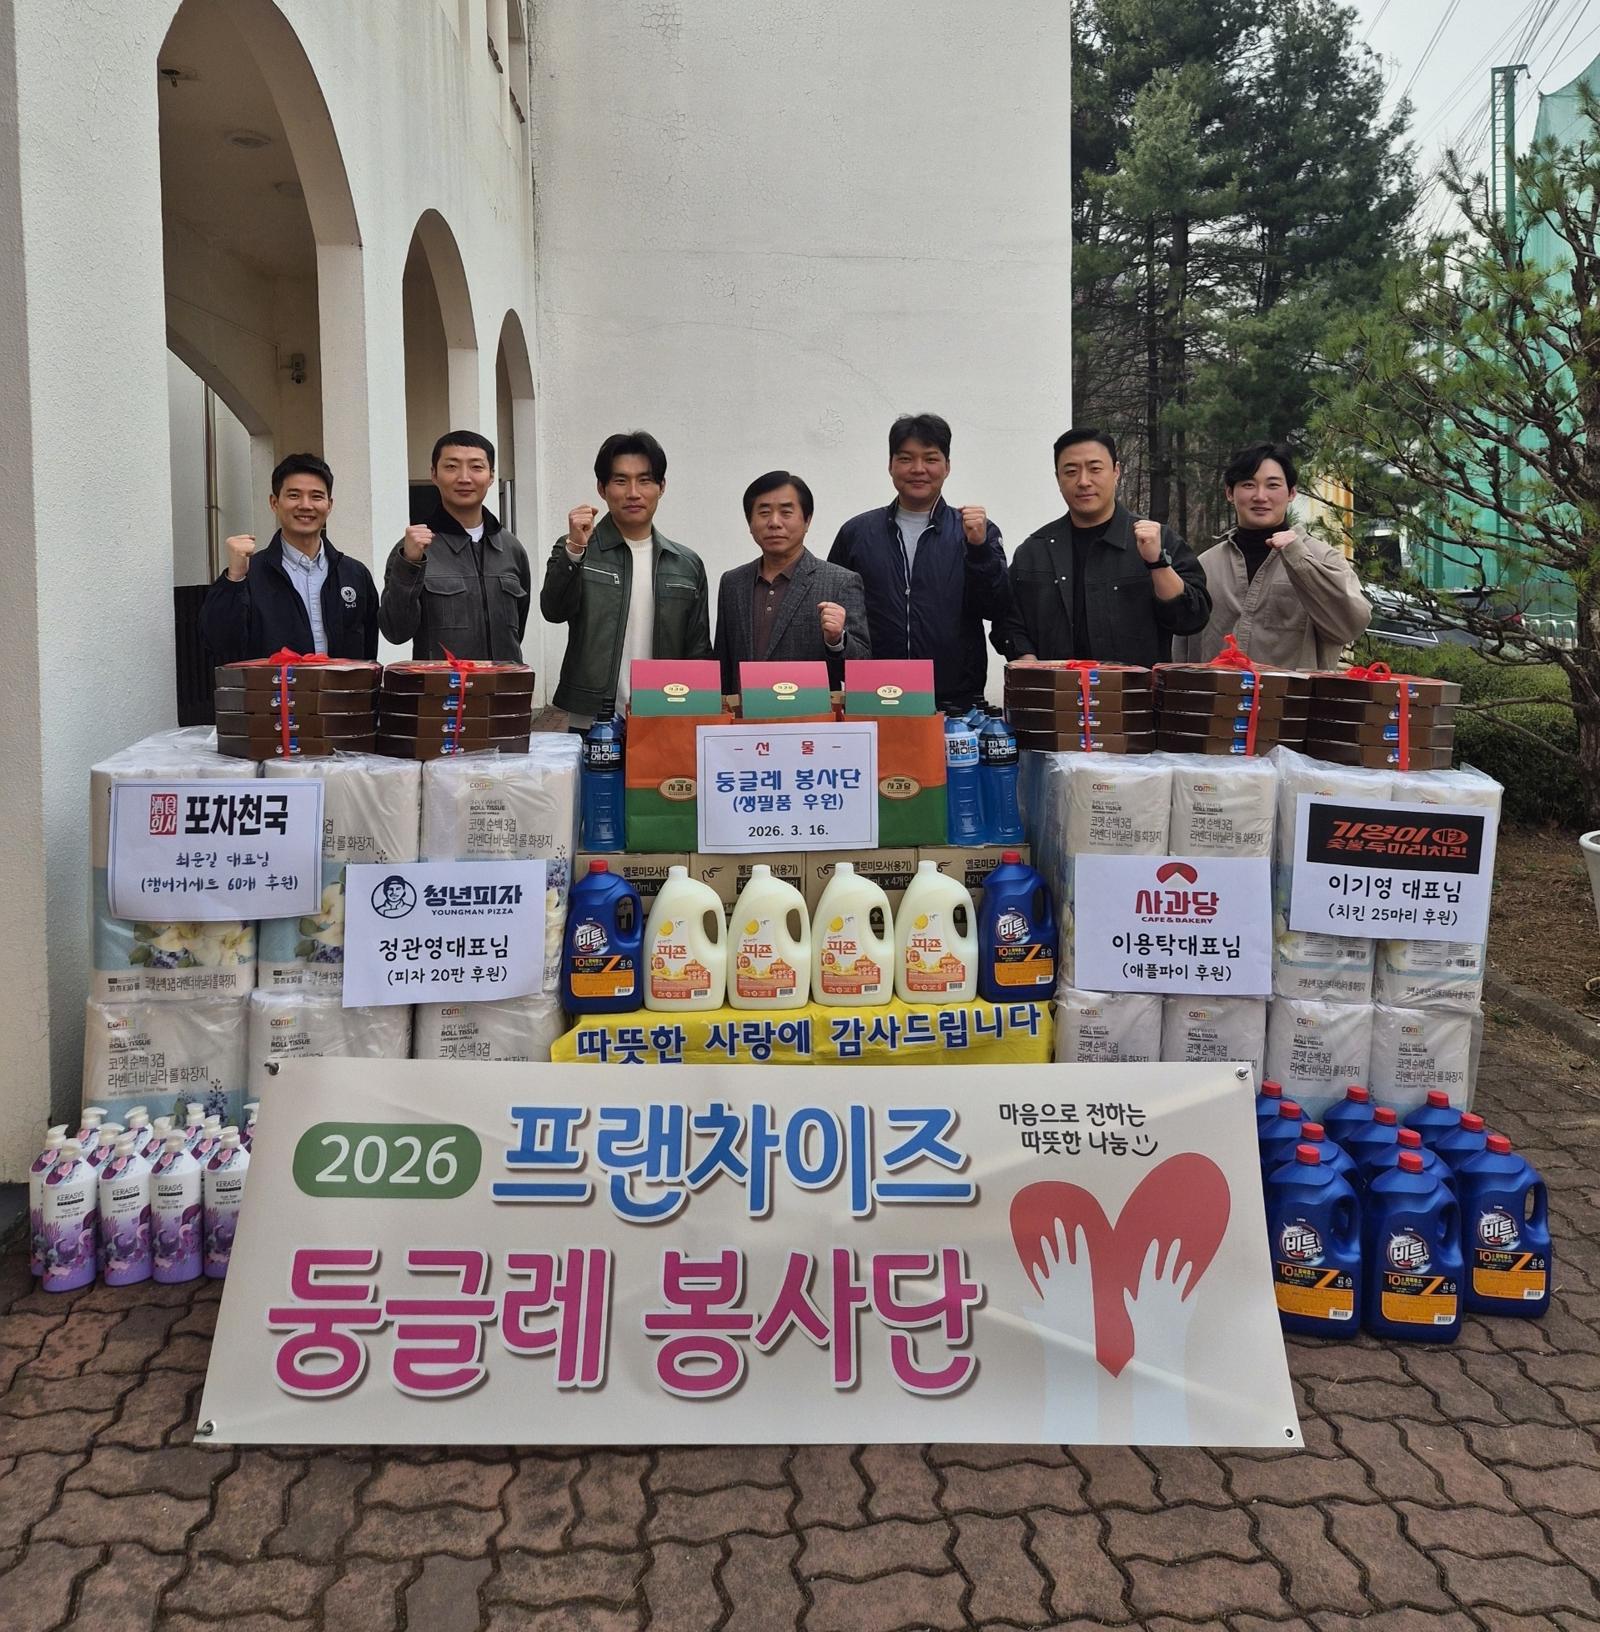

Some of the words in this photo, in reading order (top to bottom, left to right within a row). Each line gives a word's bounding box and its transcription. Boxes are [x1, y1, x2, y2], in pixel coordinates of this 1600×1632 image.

[755, 742, 770, 756] 선
[801, 740, 815, 755] 물
[716, 770, 782, 792] 둥글레
[795, 768, 861, 790] 봉사단
[733, 794, 792, 813] (생필품
[803, 793, 843, 811] 후원)
[185, 794, 288, 835] 포차천국
[748, 826, 784, 837] 2026.
[791, 825, 801, 836] 3.
[809, 825, 828, 836] 16.
[1333, 821, 1430, 843] 기영이
[227, 851, 270, 868] 대표님
[1365, 841, 1467, 858] 두마리치킨
[141, 876, 219, 892] (햄버거세트
[228, 875, 256, 891] 60개
[265, 874, 298, 891] 후원)
[1329, 873, 1392, 900] 이기영
[1402, 878, 1461, 903] 대표님
[423, 885, 523, 907] 청년피자
[1135, 890, 1220, 916] 사과당
[1328, 903, 1365, 921] (치킨
[1371, 908, 1417, 924] 25마리
[1423, 908, 1457, 926] 후원)
[1000, 917, 1025, 936] 비트
[577, 928, 602, 946] 비트
[911, 938, 941, 952] 피죤
[1112, 932, 1240, 959] 이용탁대표님
[379, 935, 509, 962] 정관영대표님
[657, 945, 687, 959] 피죤
[742, 944, 773, 958] 피죤
[827, 940, 857, 955] 피죤
[388, 968, 425, 986] (피자
[431, 966, 464, 984] 20판
[471, 966, 507, 983] 후원)
[1122, 963, 1188, 980] (애플파이
[1195, 964, 1232, 982] 후원)
[577, 1024, 686, 1064] 따뜻한
[704, 1020, 811, 1060] 사랑에
[830, 1003, 1041, 1058] 감사드립니다
[999, 1103, 1080, 1127] 마음으로
[1086, 1103, 1146, 1127] 전하는
[1021, 1131, 1081, 1155] 따뜻한
[1088, 1131, 1129, 1156] 나눔
[314, 1132, 459, 1186] 2026
[491, 1103, 974, 1221] 프랜차이즈
[1484, 1219, 1513, 1238] 비트
[1286, 1232, 1316, 1251] 비트
[1393, 1242, 1424, 1260] 비트
[267, 1248, 609, 1392] 둥글레
[644, 1248, 979, 1393] 봉사단
